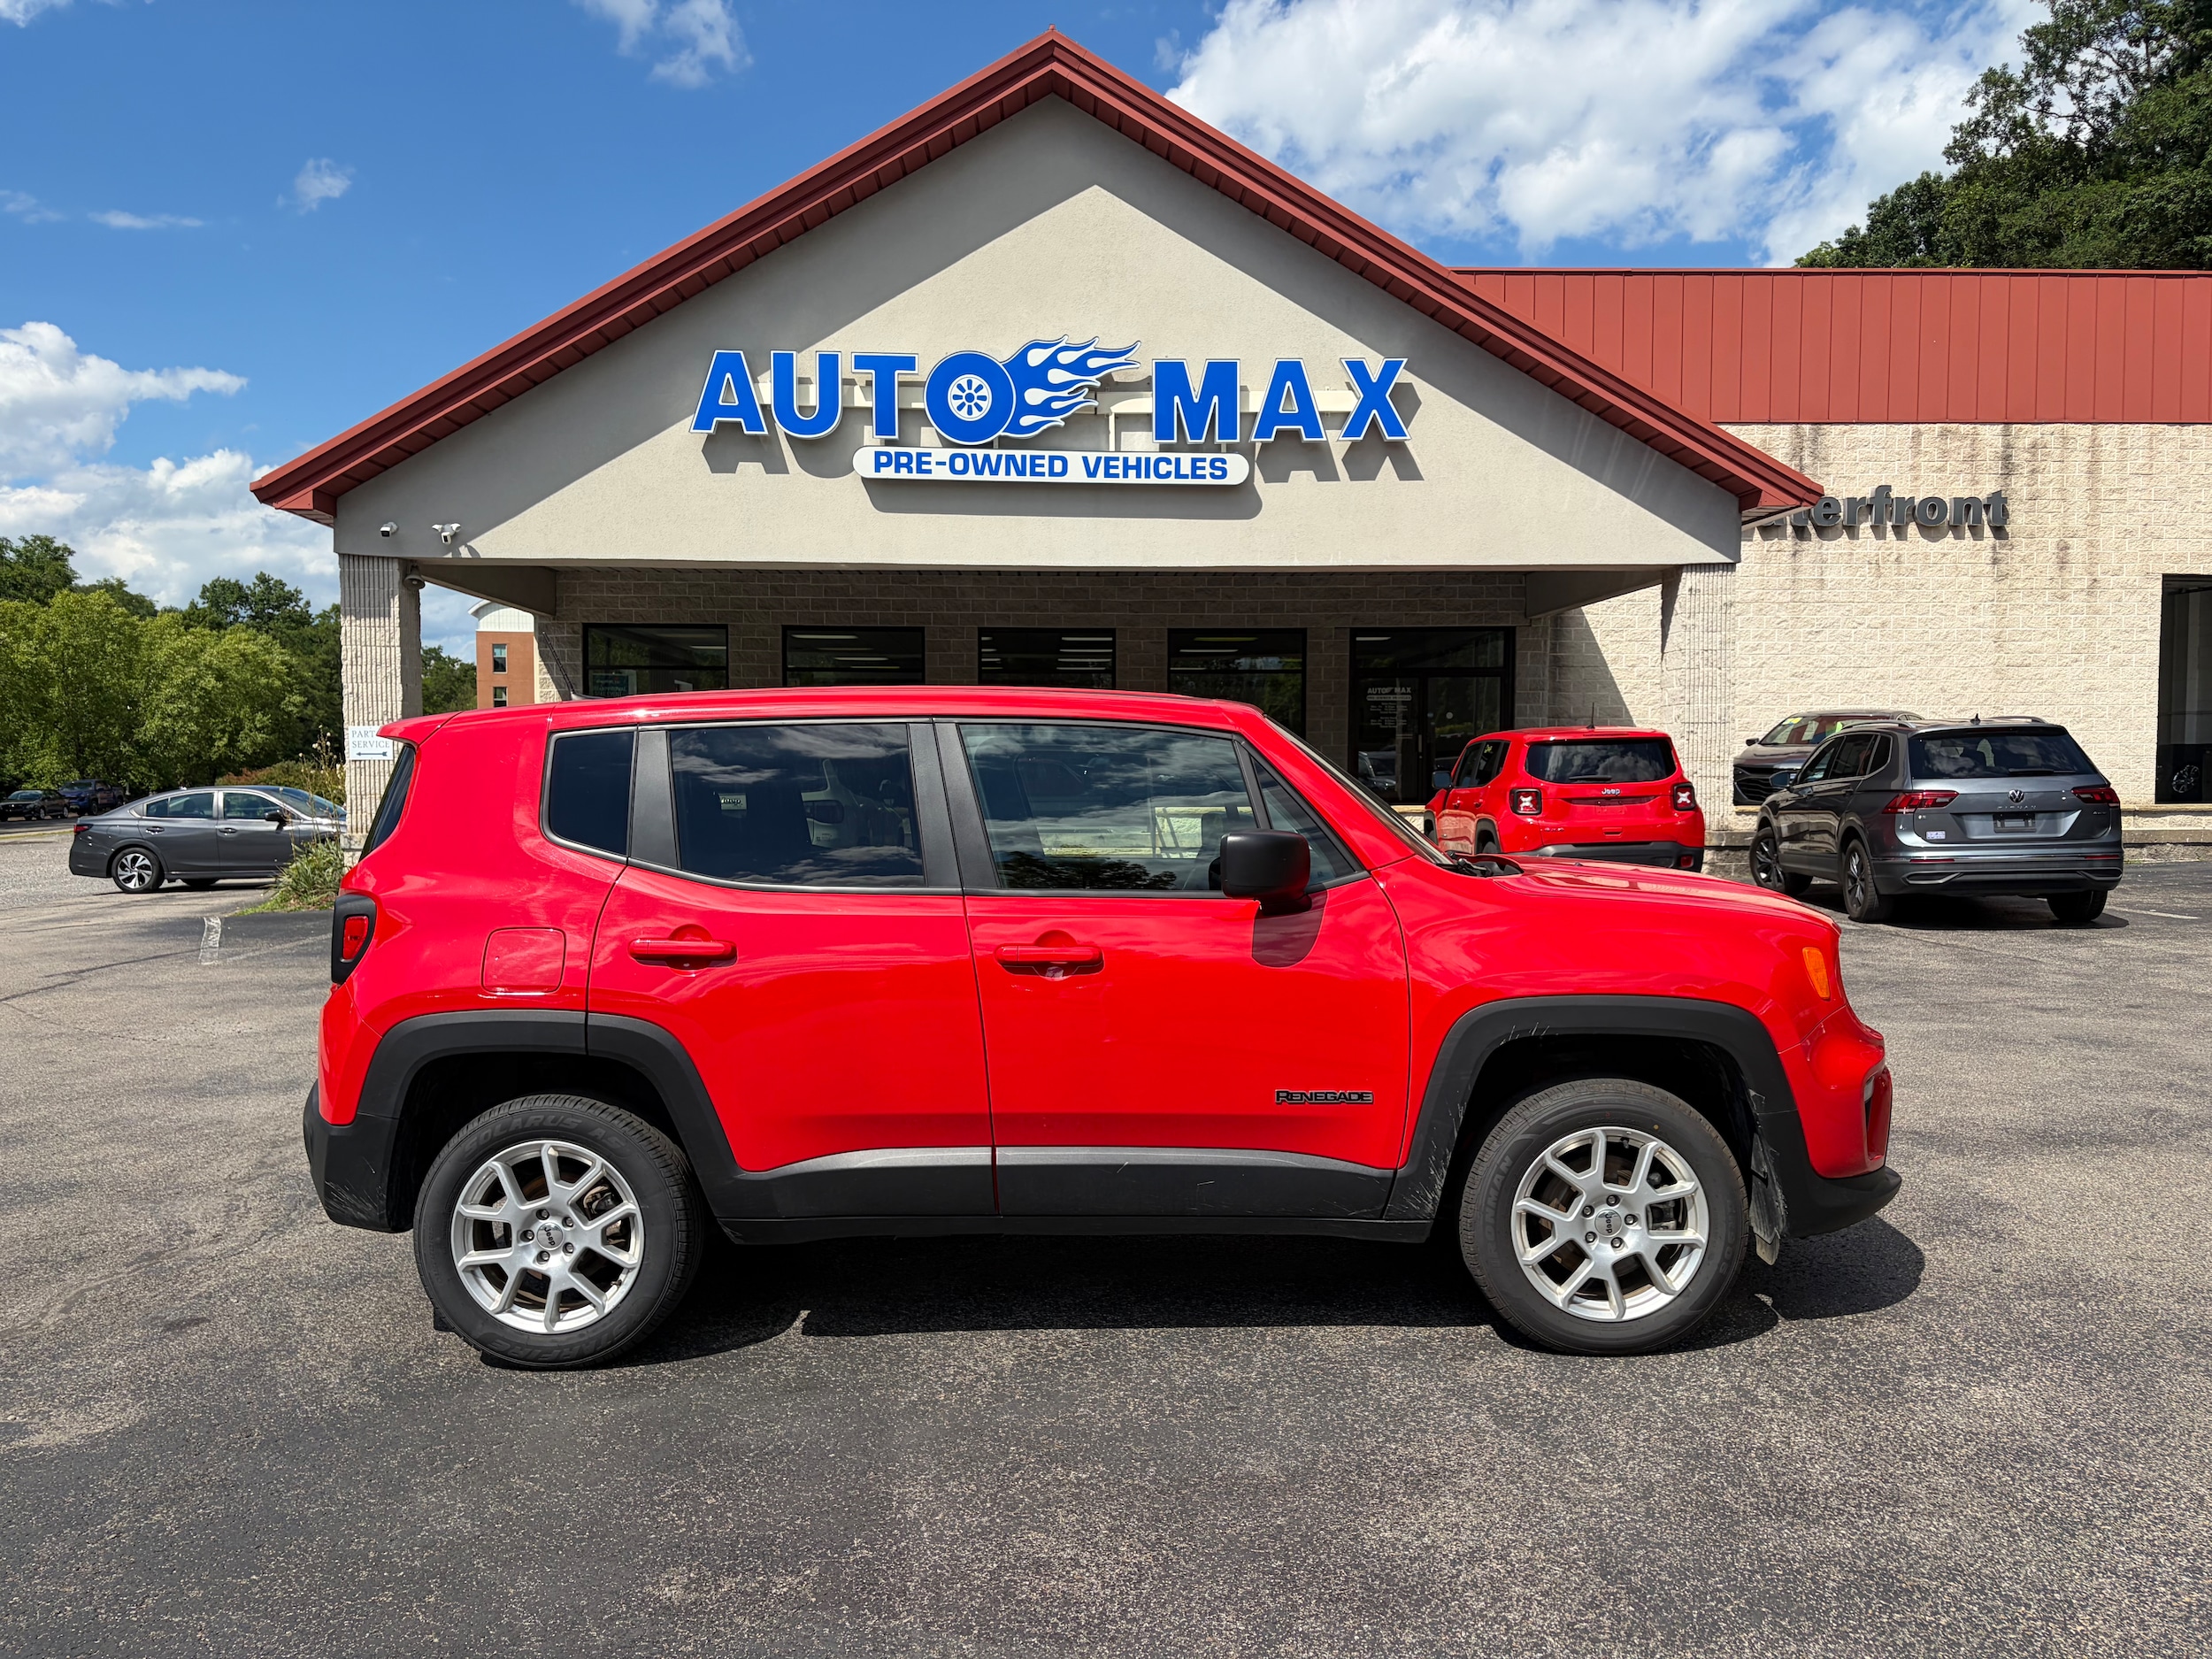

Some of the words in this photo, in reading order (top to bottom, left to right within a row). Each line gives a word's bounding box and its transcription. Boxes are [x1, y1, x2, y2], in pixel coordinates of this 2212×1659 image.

[689, 349, 1016, 445] AUTO
[1152, 357, 1412, 443] MAX
[873, 451, 1069, 478] PRE-OWNED
[1081, 455, 1228, 481] VEHICLES
[1763, 485, 2007, 526] erfront
[351, 740, 390, 749] SERVICE
[1275, 1089, 1374, 1104] RENEGADE
[464, 1114, 584, 1153] SOLARUS
[1484, 1155, 1513, 1268] IRONMAN
[1604, 1213, 1613, 1233] Jeep
[543, 1226, 556, 1246] Jeep
[488, 1319, 629, 1361] STARFIRE
